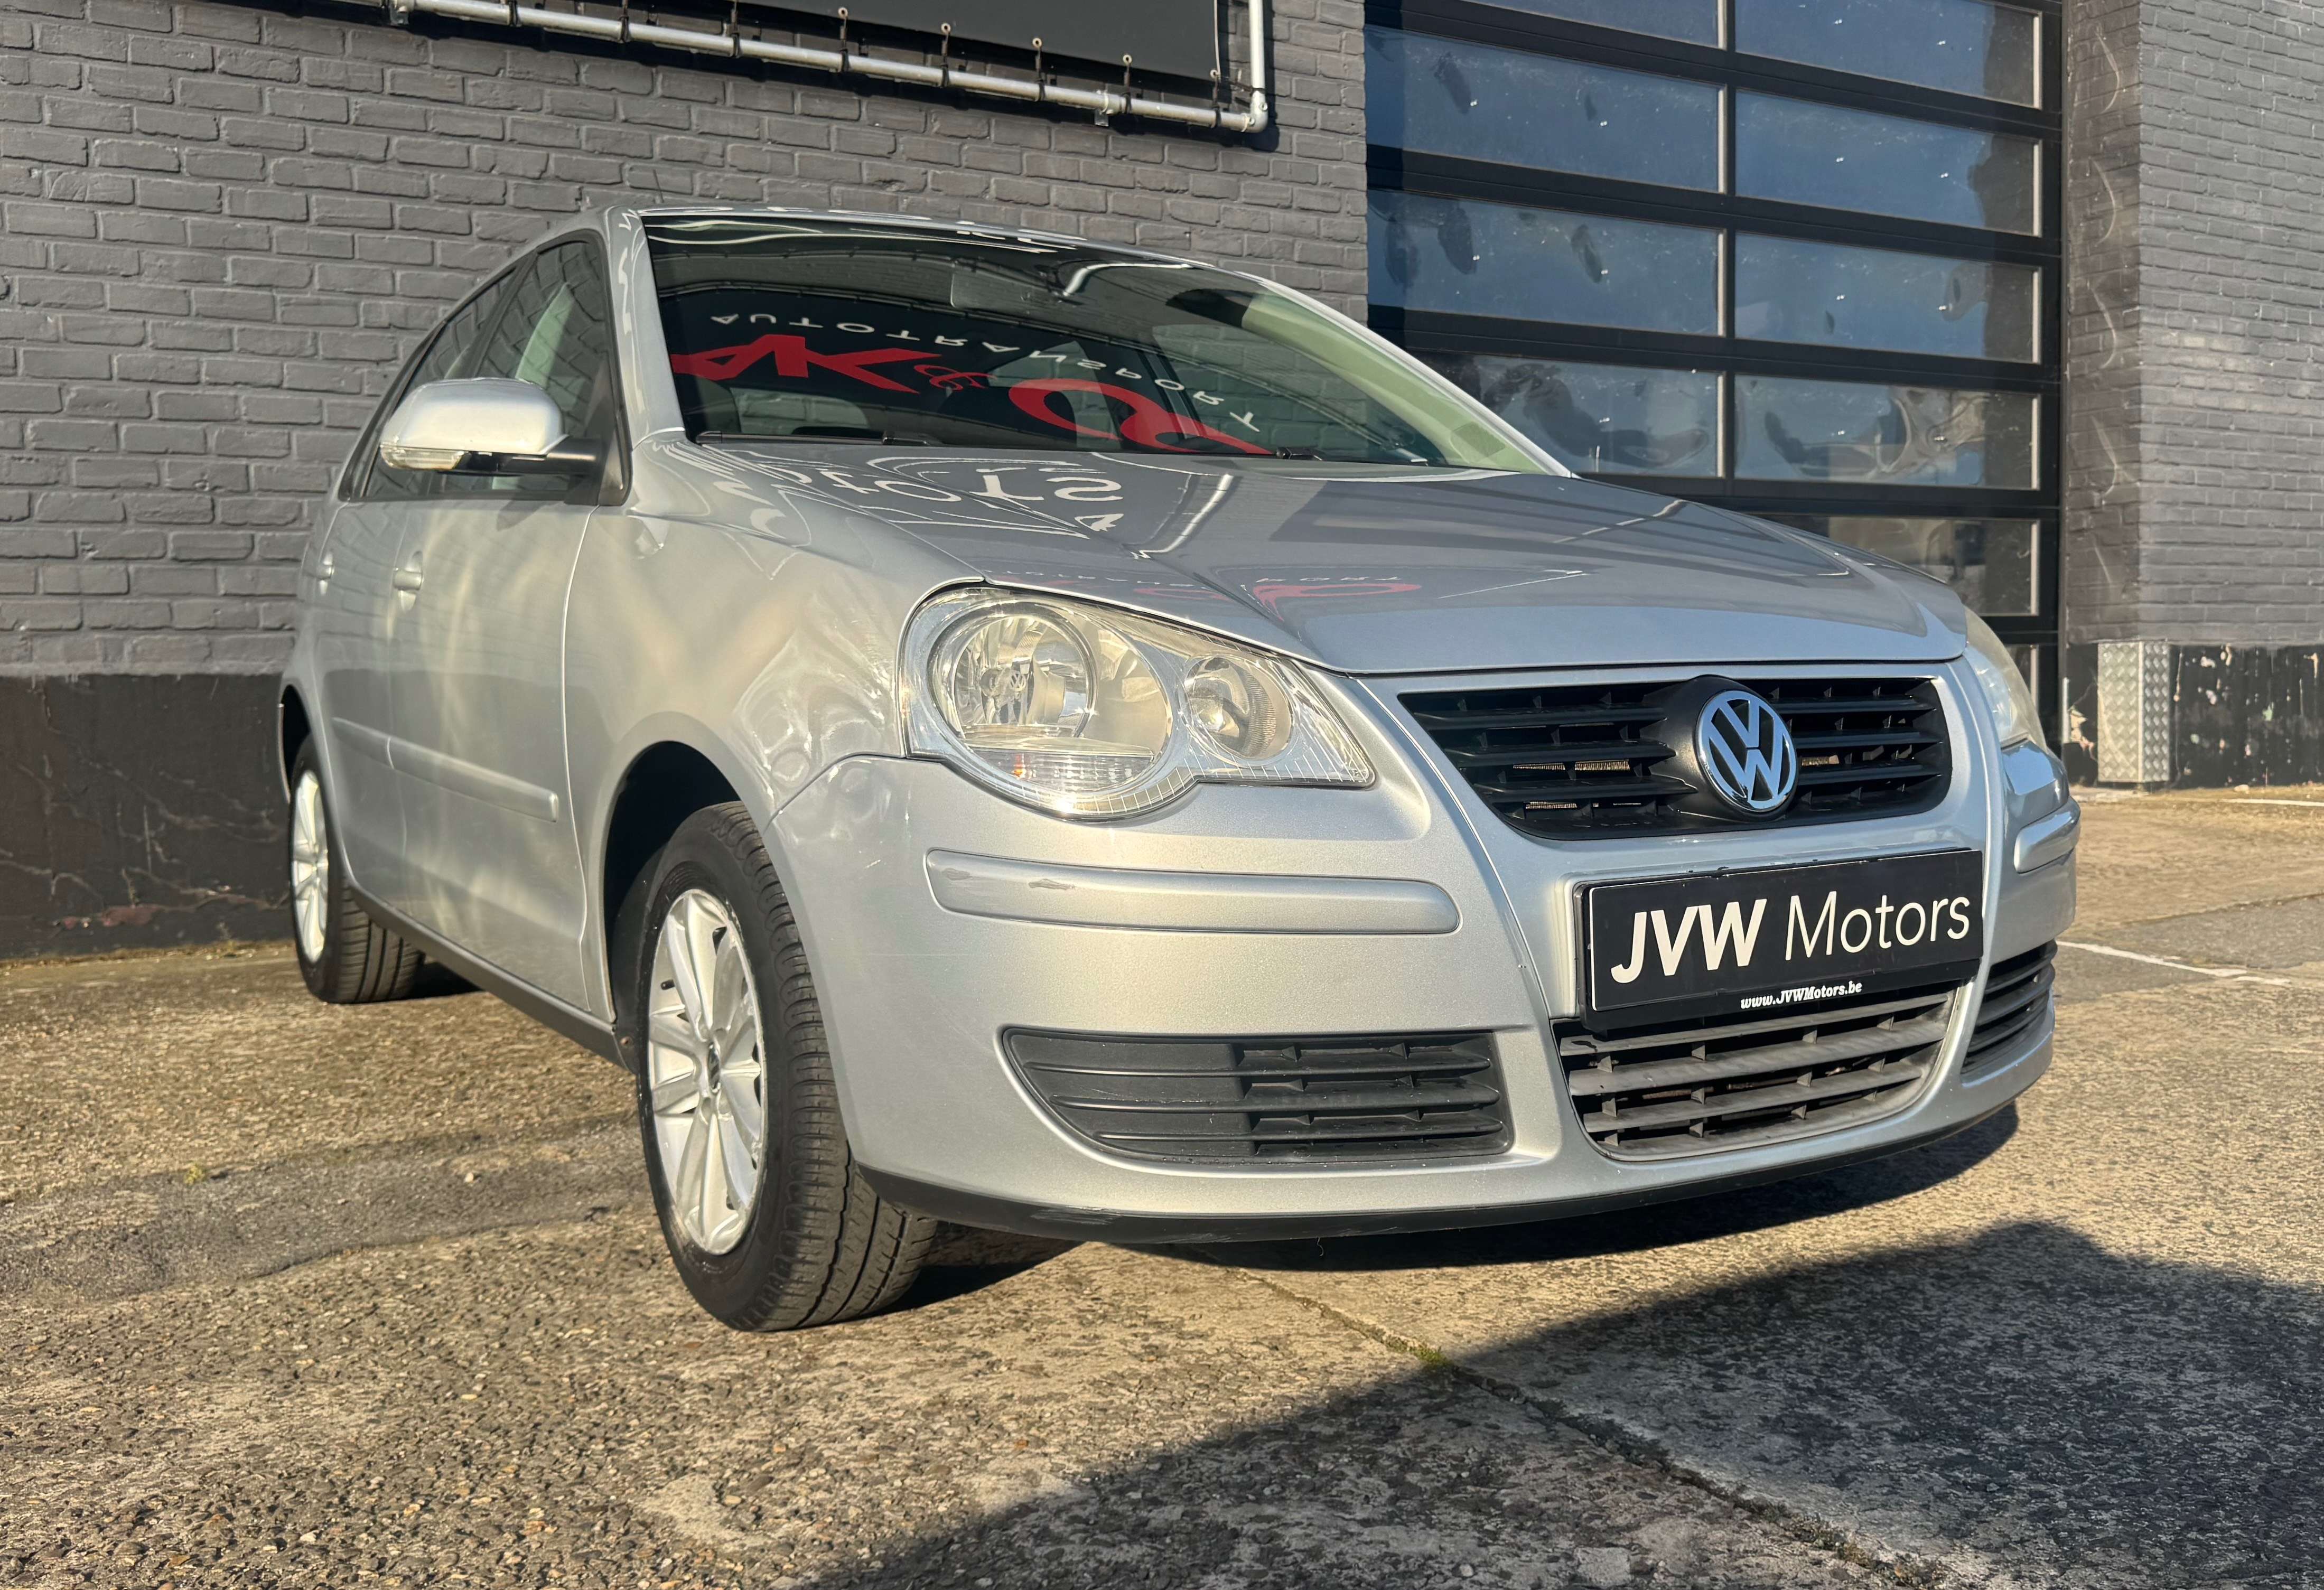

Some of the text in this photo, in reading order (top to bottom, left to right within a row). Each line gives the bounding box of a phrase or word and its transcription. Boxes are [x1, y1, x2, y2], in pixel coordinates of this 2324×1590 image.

[1697, 690, 1795, 810] VW
[1610, 890, 1971, 984] JVW Motors
[1740, 980, 1863, 1009] www.JVWMotors.be
